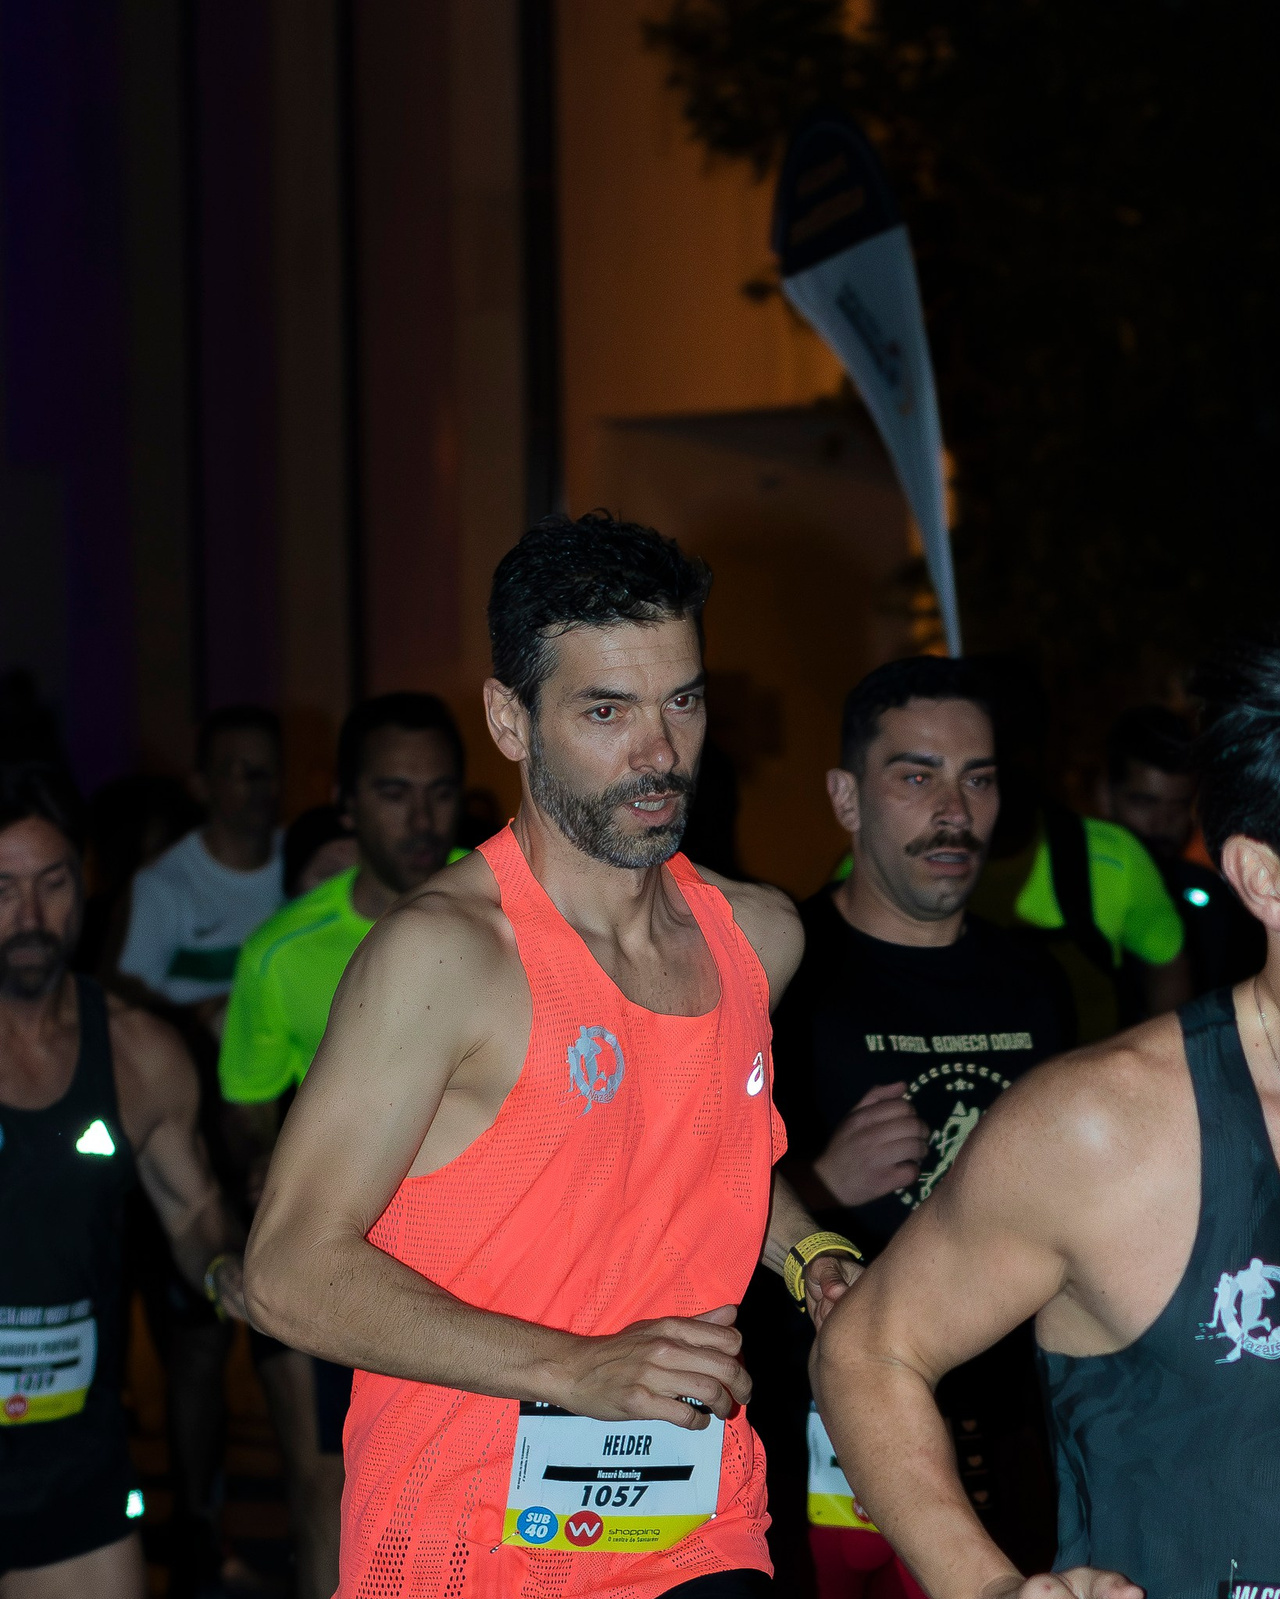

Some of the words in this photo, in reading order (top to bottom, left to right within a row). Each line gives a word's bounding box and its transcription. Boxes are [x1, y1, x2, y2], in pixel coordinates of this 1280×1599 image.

[602, 1435, 652, 1456] HELDER
[581, 1485, 649, 1508] 1057
[526, 1513, 550, 1524] SUB
[525, 1525, 549, 1538] 40
[568, 1522, 600, 1538] W
[608, 1528, 660, 1536] shopping
